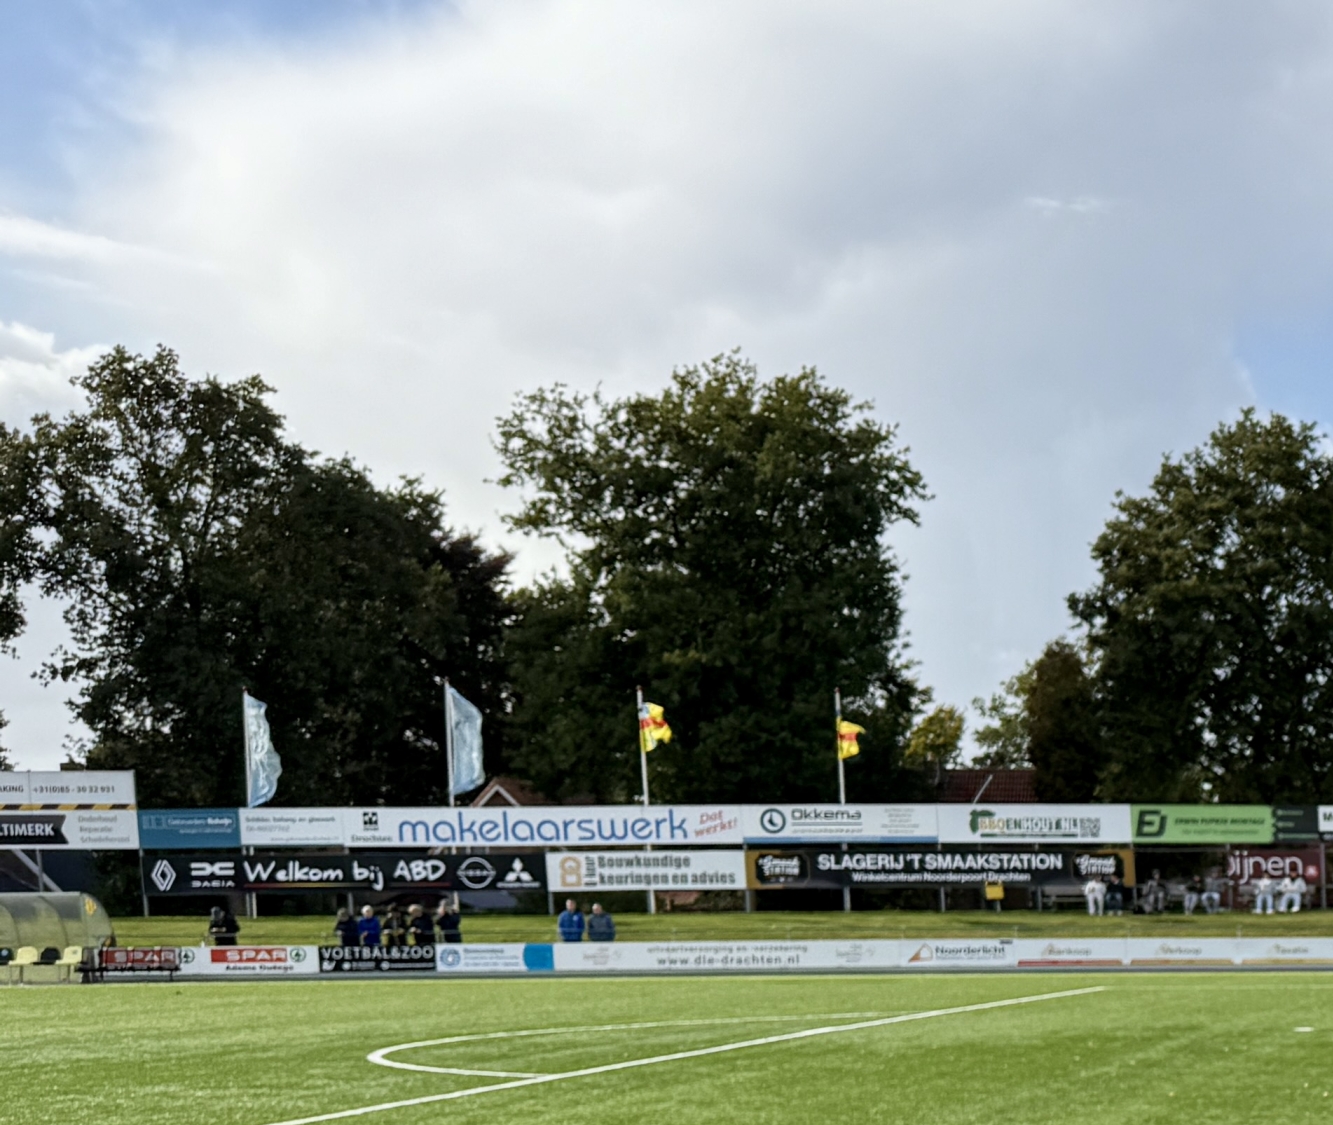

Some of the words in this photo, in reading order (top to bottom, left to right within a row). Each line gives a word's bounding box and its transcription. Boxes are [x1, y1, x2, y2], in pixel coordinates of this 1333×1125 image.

[700, 810, 723, 825] Dat
[791, 808, 862, 821] Okkema
[0, 823, 54, 836] TIMERK
[398, 808, 688, 842] makelaarswerk
[598, 854, 691, 869] Bouwkundige
[817, 853, 905, 870] SLAGERIJ
[924, 853, 1063, 870] SMAAKSTATION
[243, 860, 344, 882] Welkom
[352, 859, 384, 891] bij
[393, 859, 446, 882] ABD
[599, 871, 669, 886] keuringen
[672, 874, 688, 885] en
[691, 871, 736, 885] advies
[226, 950, 286, 962] SPAR
[321, 945, 434, 961] VOETBAL&ZOO
